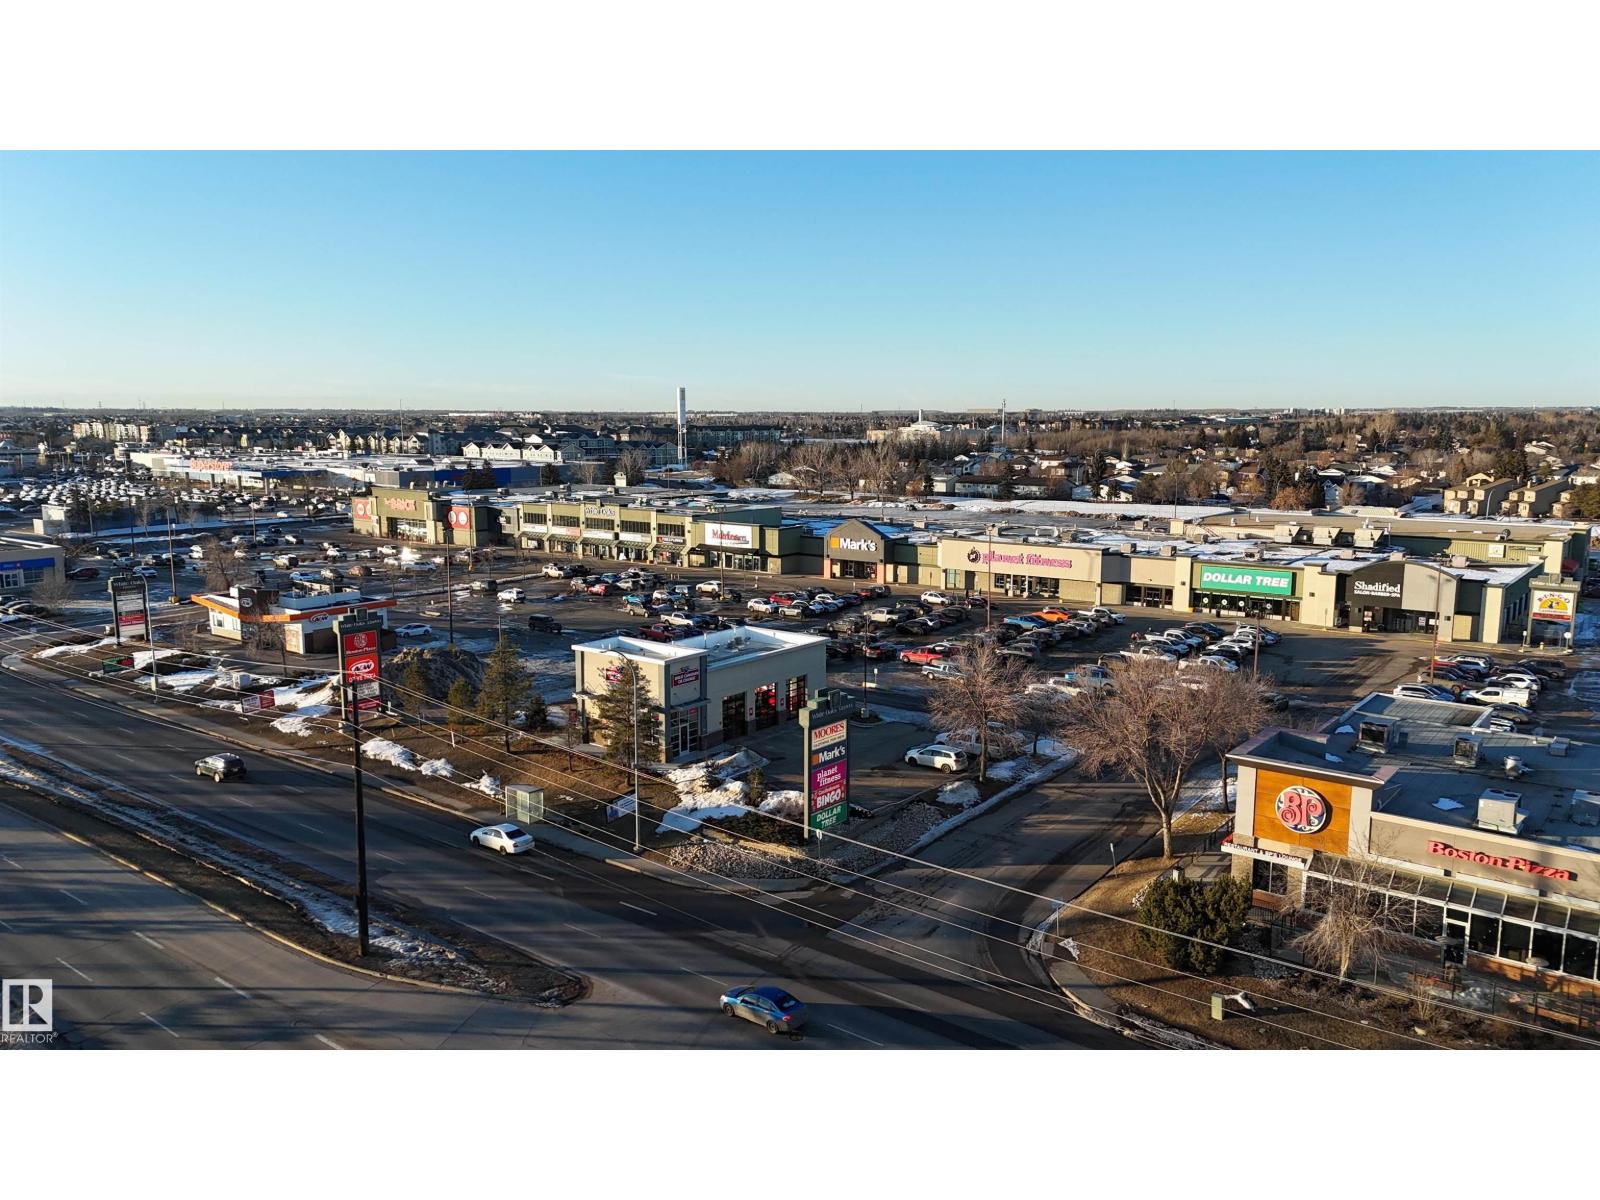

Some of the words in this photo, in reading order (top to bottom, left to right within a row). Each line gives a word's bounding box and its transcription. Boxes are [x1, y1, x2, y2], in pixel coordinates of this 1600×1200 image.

[840, 537, 877, 552] Mark's
[982, 550, 1024, 564] planet
[1026, 554, 1072, 569] fitness
[1203, 572, 1253, 585] DOLLAR
[1255, 576, 1289, 588] TREE
[1354, 581, 1400, 593] Shadified
[354, 663, 373, 672] A&W
[813, 722, 845, 740] MOORES
[818, 745, 846, 763] Mark's
[817, 765, 838, 782] planet
[819, 773, 842, 786] fitness
[816, 789, 841, 808] BINGO
[816, 805, 842, 822] DOLLAR
[821, 815, 837, 829] TREE
[1427, 840, 1505, 869] Boston
[1507, 857, 1572, 881] Pizza
